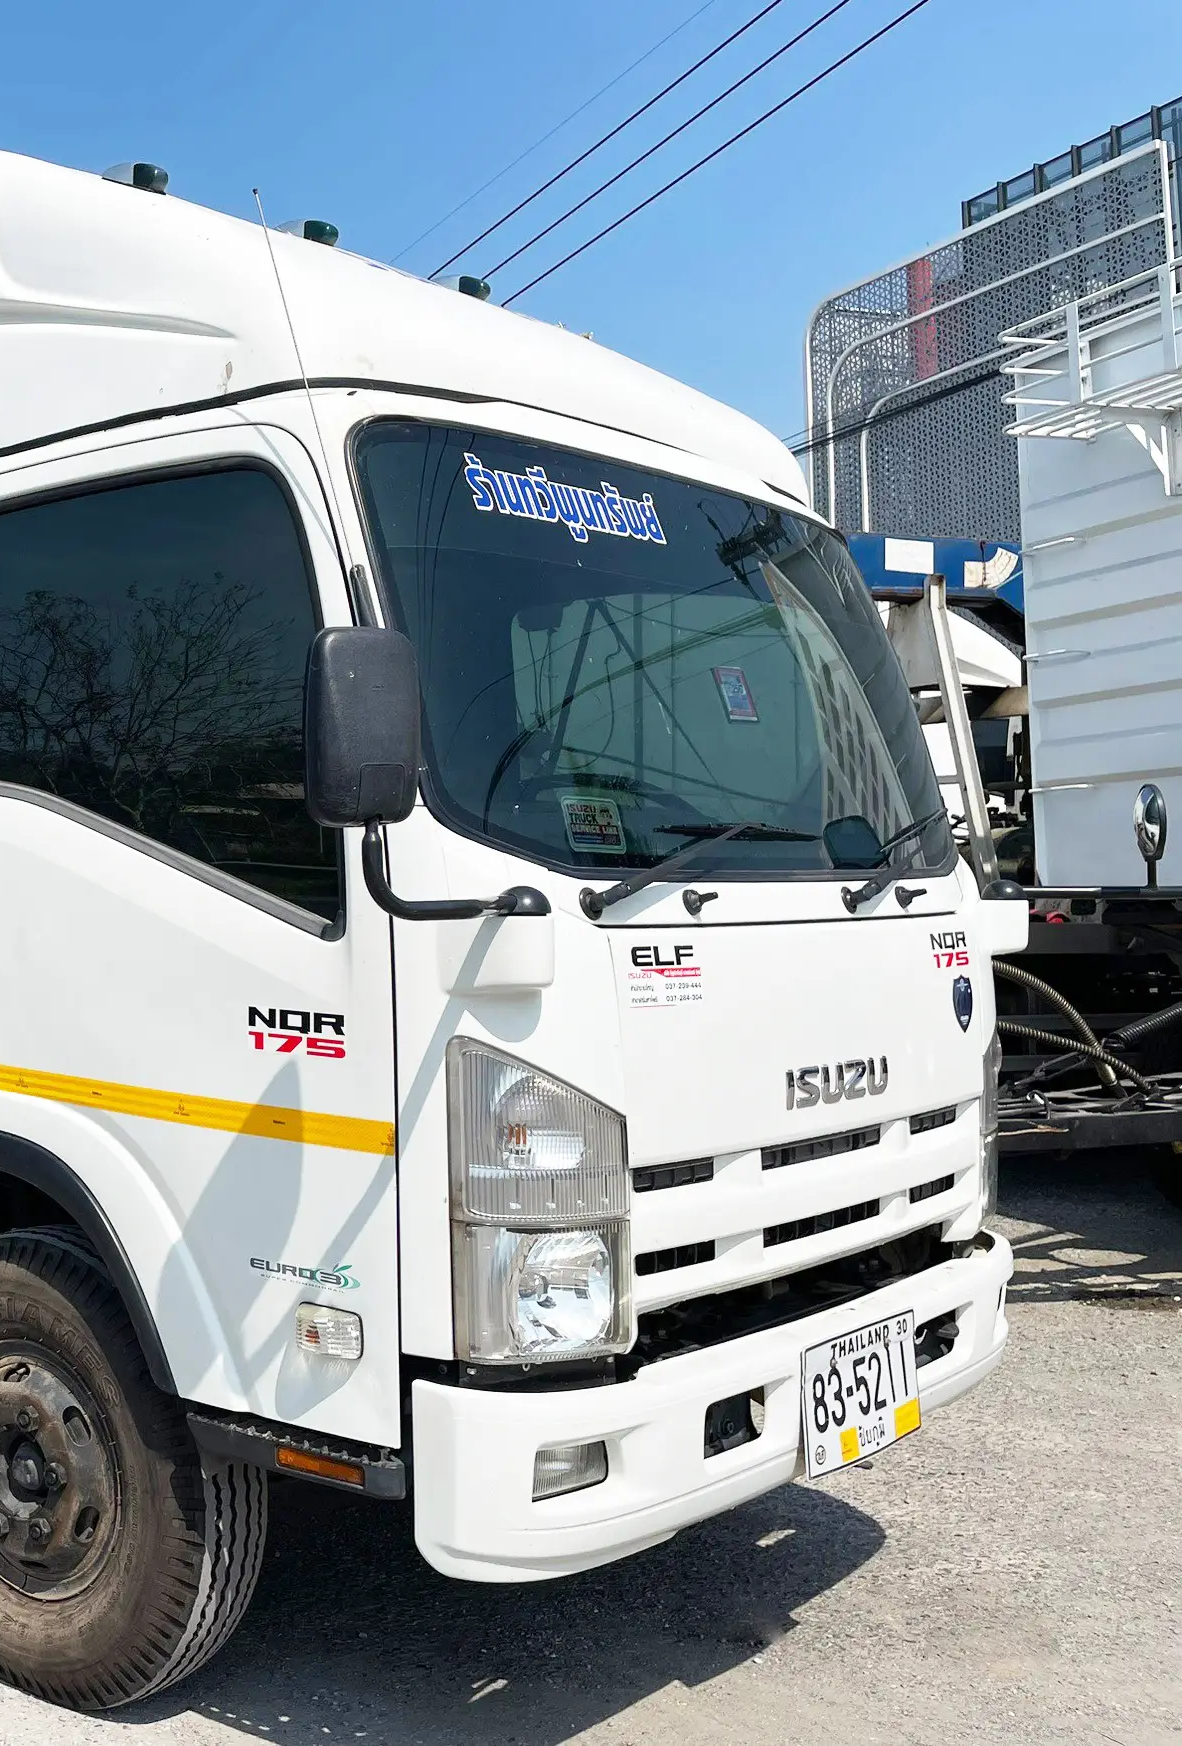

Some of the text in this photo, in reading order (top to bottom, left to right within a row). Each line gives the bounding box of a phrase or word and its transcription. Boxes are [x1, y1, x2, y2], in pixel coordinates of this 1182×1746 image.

[464, 452, 667, 545] ร้านทวีพูนทรัพย์
[567, 803, 596, 813] ISUZU
[569, 813, 599, 824] TRUCK
[930, 931, 967, 950] NQR
[631, 945, 694, 967] ELF
[932, 951, 969, 968] 175
[248, 1006, 345, 1036] NQR
[248, 1031, 346, 1059] 175
[785, 1055, 888, 1111] ISUZU
[830, 1319, 908, 1360] THAILAND 30
[812, 1341, 909, 1434] 83-5211
